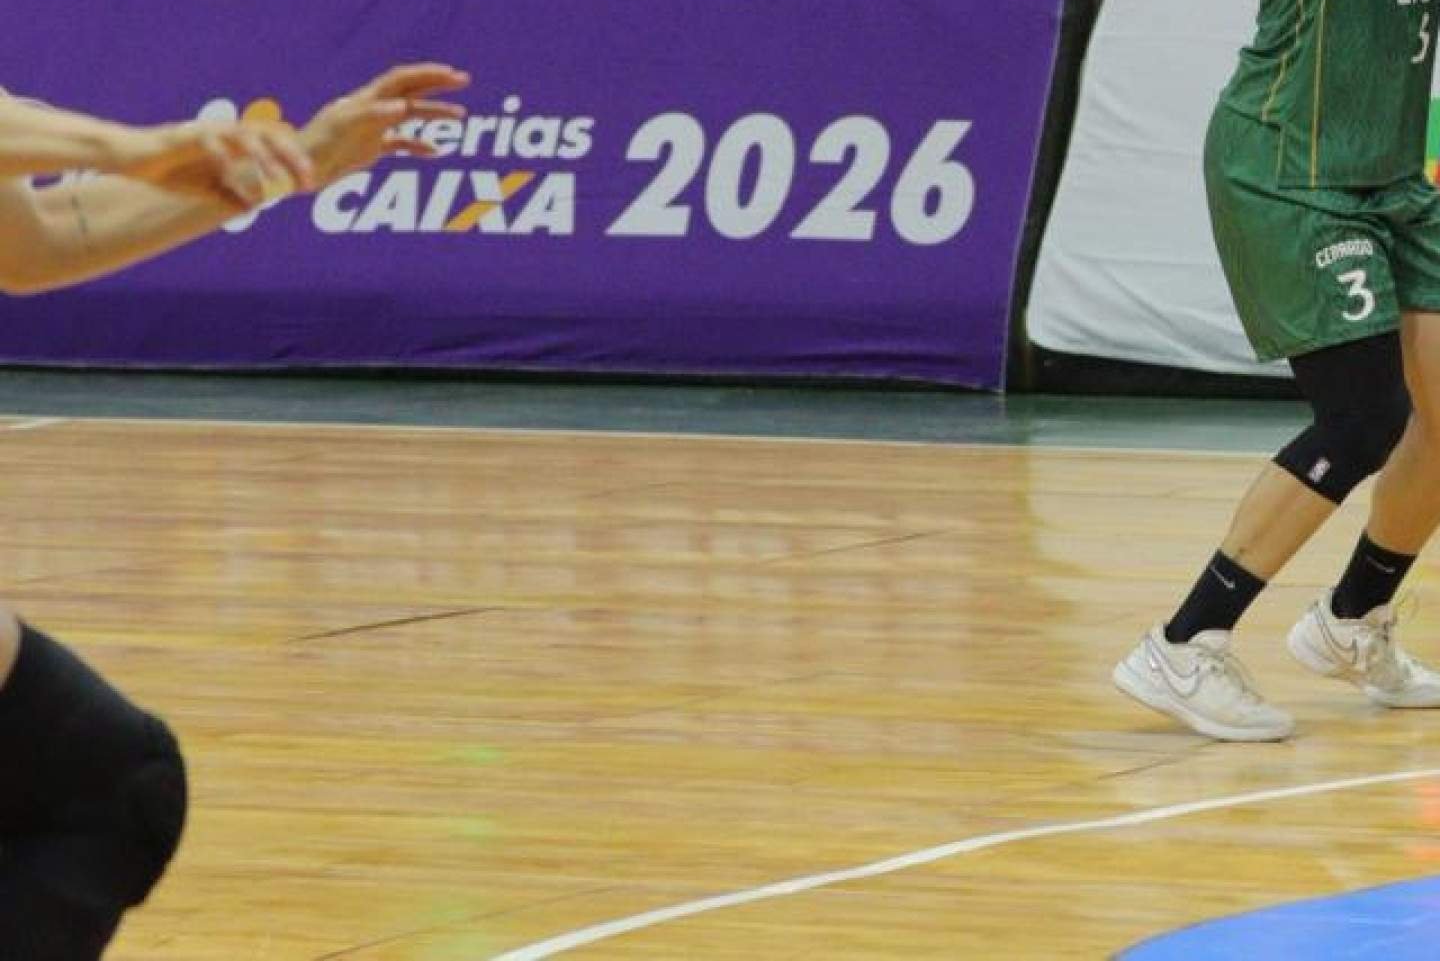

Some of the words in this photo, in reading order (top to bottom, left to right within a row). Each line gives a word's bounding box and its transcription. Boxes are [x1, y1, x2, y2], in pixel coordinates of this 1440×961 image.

[311, 170, 575, 236] CAIXA
[605, 112, 976, 246] 2026
[1337, 269, 1376, 321] 3
